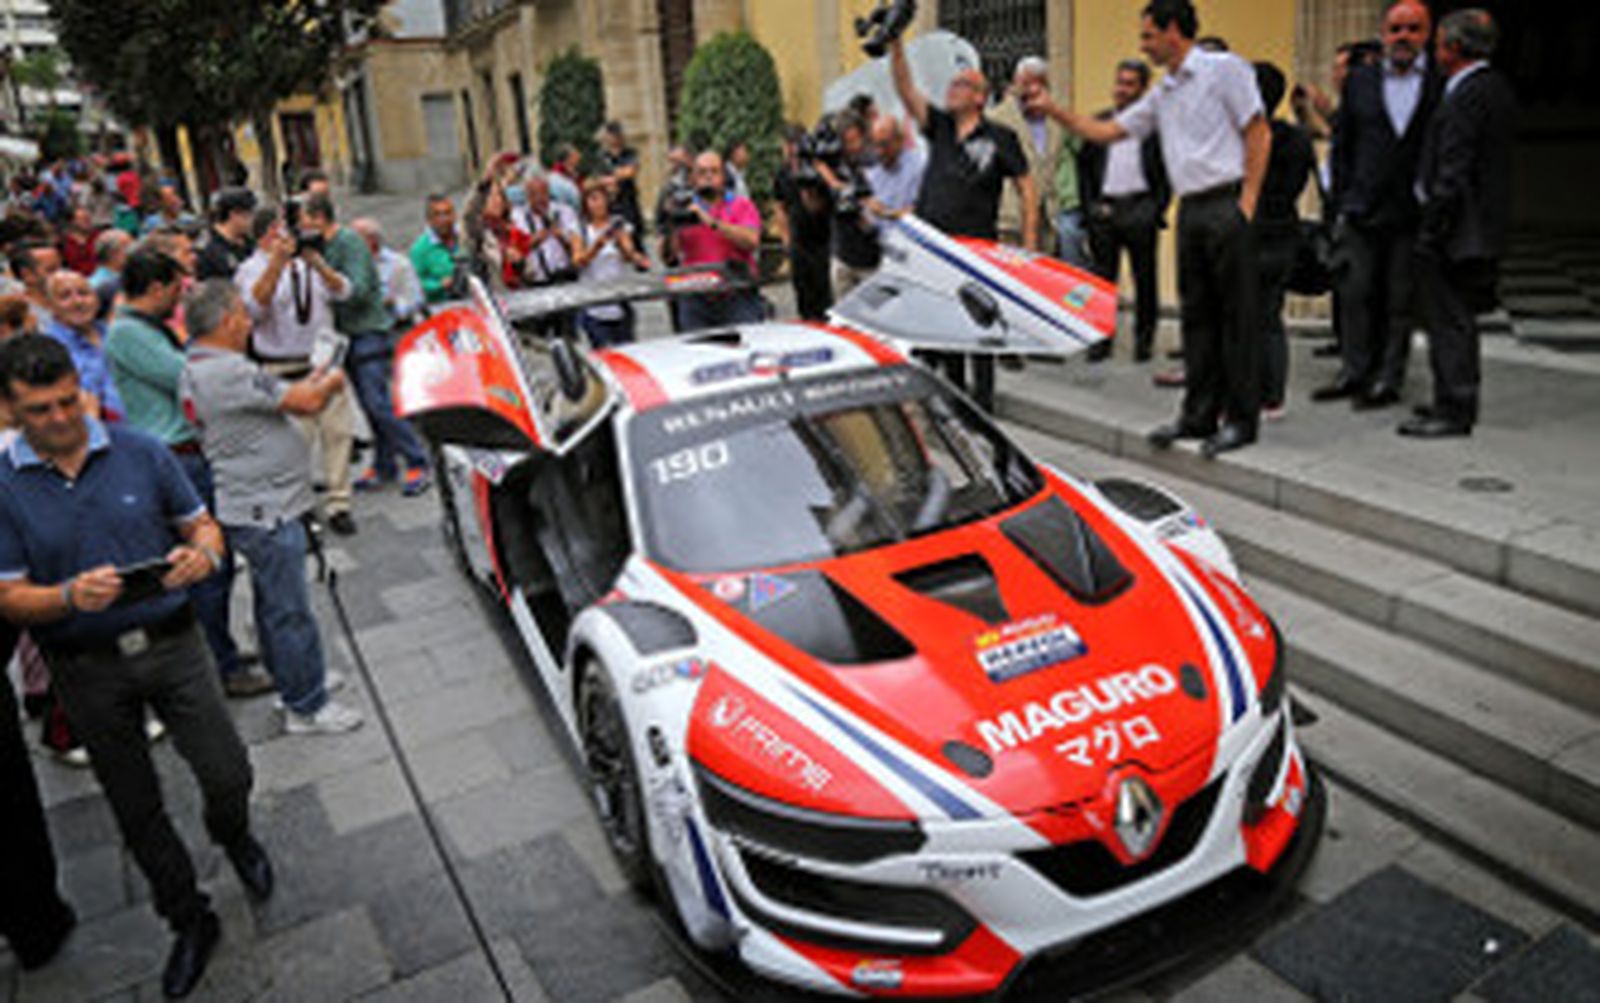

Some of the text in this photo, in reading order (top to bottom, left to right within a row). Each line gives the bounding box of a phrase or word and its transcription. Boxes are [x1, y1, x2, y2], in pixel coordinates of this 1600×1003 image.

[650, 440, 729, 485] 190
[976, 663, 1177, 753] MAGURO
[1054, 714, 1162, 767] マグロ
